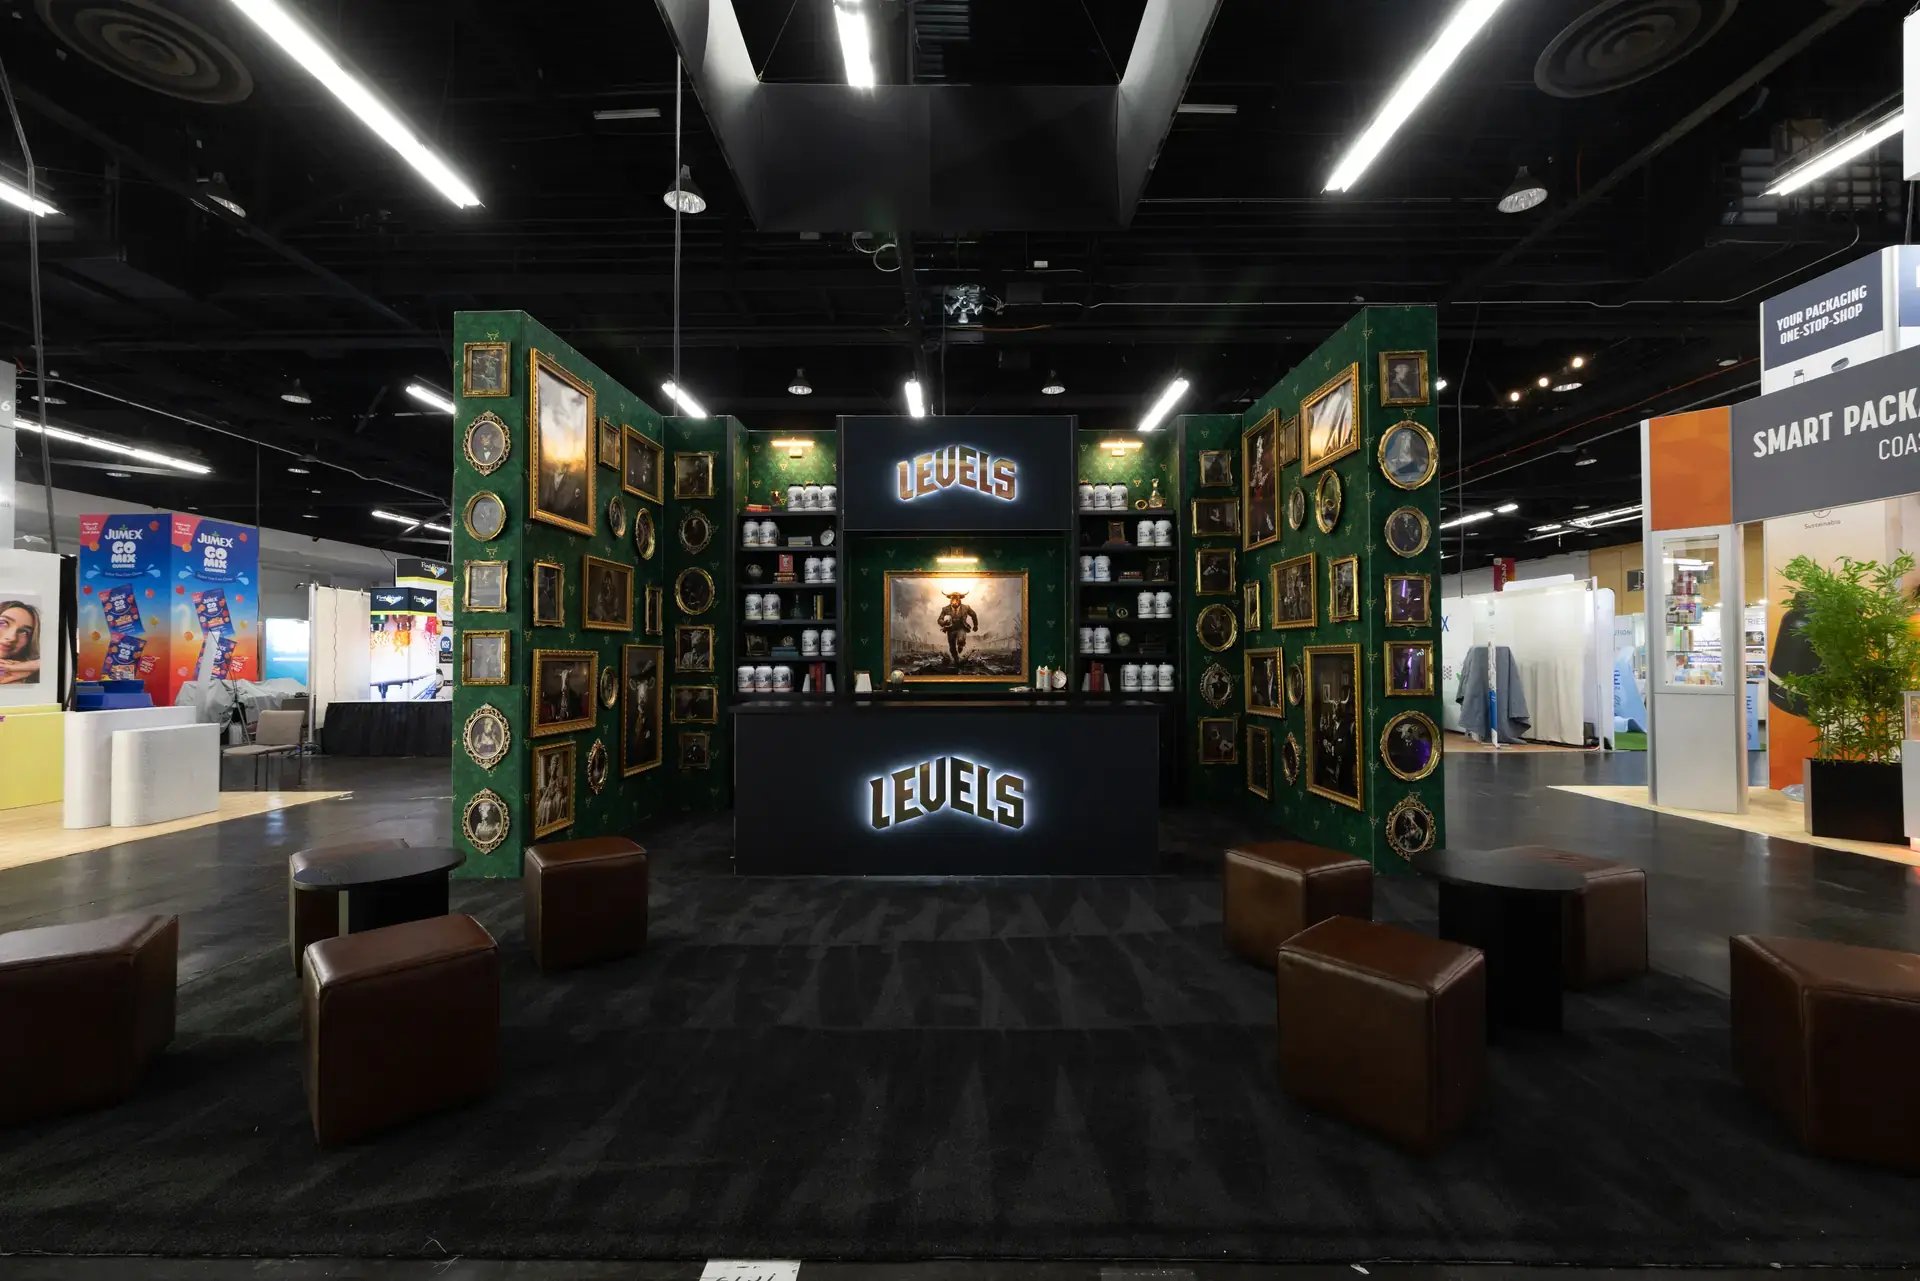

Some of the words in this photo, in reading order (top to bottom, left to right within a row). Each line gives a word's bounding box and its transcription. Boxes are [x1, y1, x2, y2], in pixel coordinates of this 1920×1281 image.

[1777, 311, 1803, 331] YOUR
[1806, 285, 1868, 323] PACKAGING
[1780, 303, 1864, 345] ONE-STOP-SHOP
[1753, 412, 1833, 458] SMART
[1844, 387, 1920, 436] PACK
[897, 444, 1017, 502] LEVELS
[104, 528, 143, 540] JUMEX
[197, 532, 233, 548] JUMEX
[111, 541, 136, 554] GO
[204, 545, 228, 560] GO
[111, 553, 136, 564] MIX
[203, 557, 227, 569] MIX
[869, 756, 1025, 830] LEVELS
